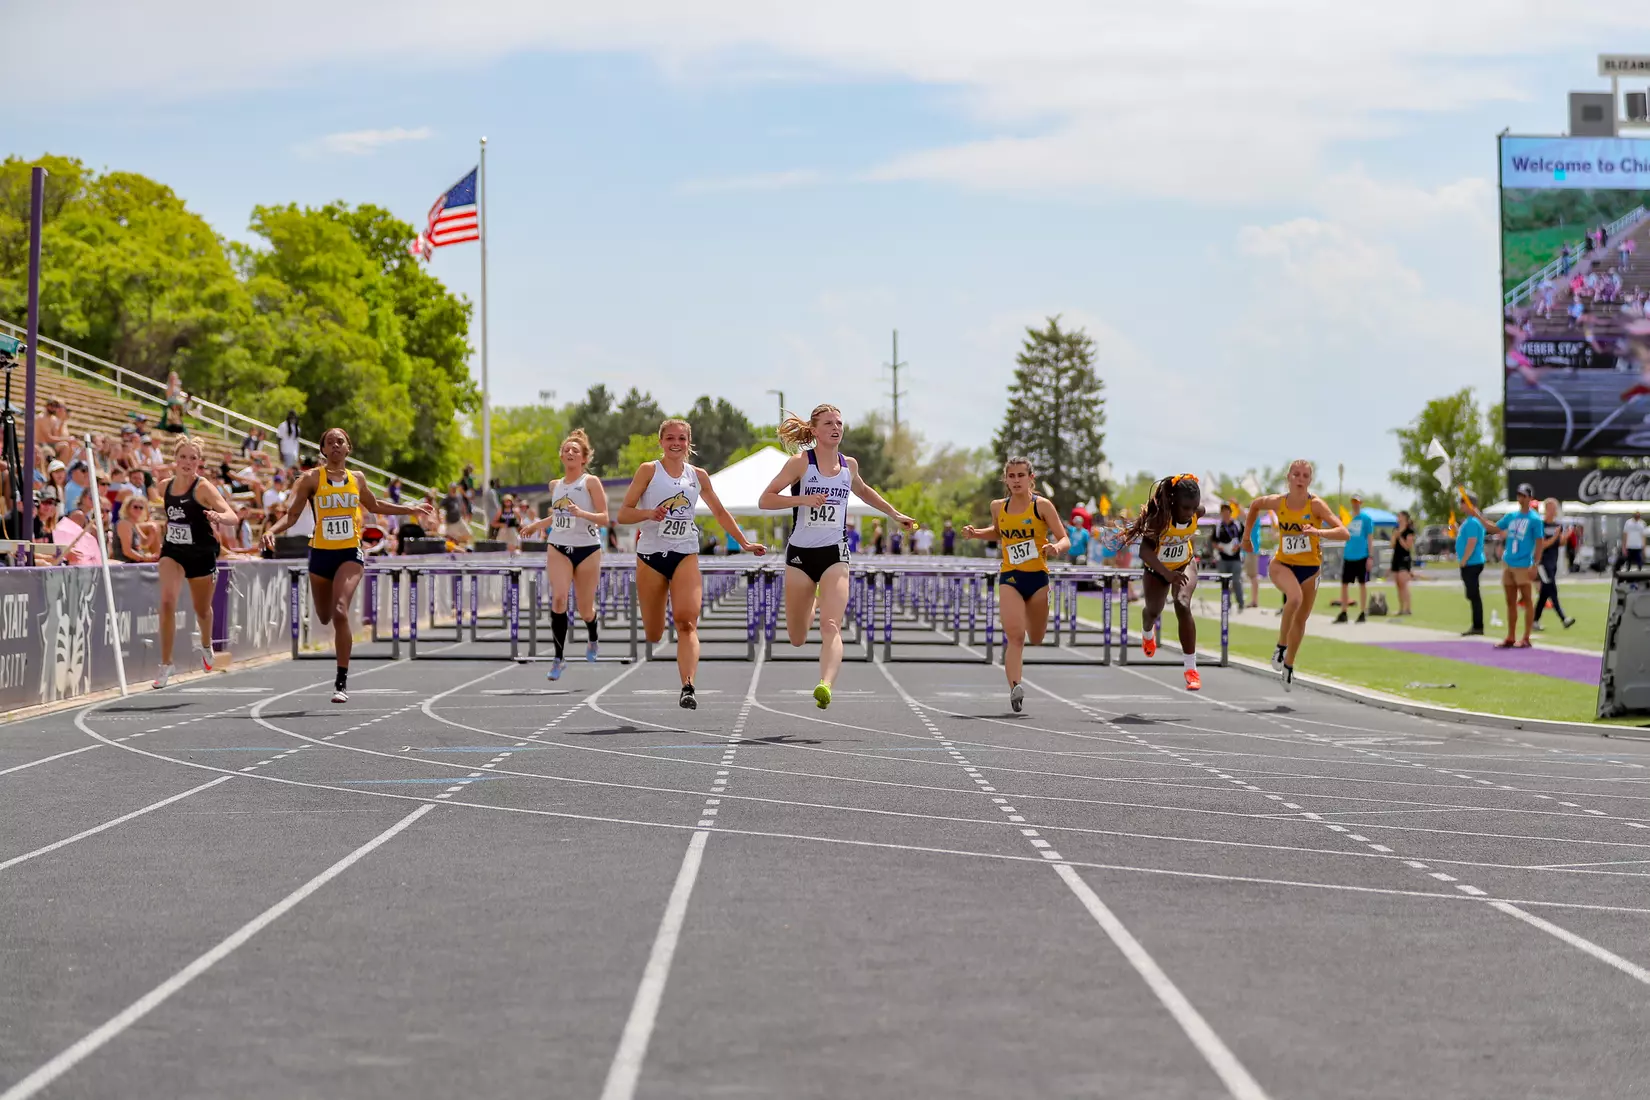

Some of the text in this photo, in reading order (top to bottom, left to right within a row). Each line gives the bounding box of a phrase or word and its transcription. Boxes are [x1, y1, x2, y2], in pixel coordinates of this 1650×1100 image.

[1512, 156, 1592, 172] Welcome
[1598, 158, 1615, 172] to
[804, 486, 849, 499] WEBER STATE
[318, 492, 360, 509] UNC
[810, 505, 836, 522] 542
[169, 526, 188, 541] 252
[327, 520, 349, 535] 410
[663, 520, 687, 536] 296
[1001, 528, 1035, 539] NAU
[1010, 542, 1031, 560] 357
[1163, 545, 1184, 558] 409
[1286, 537, 1307, 551] 373
[2, 593, 29, 640] STATE
